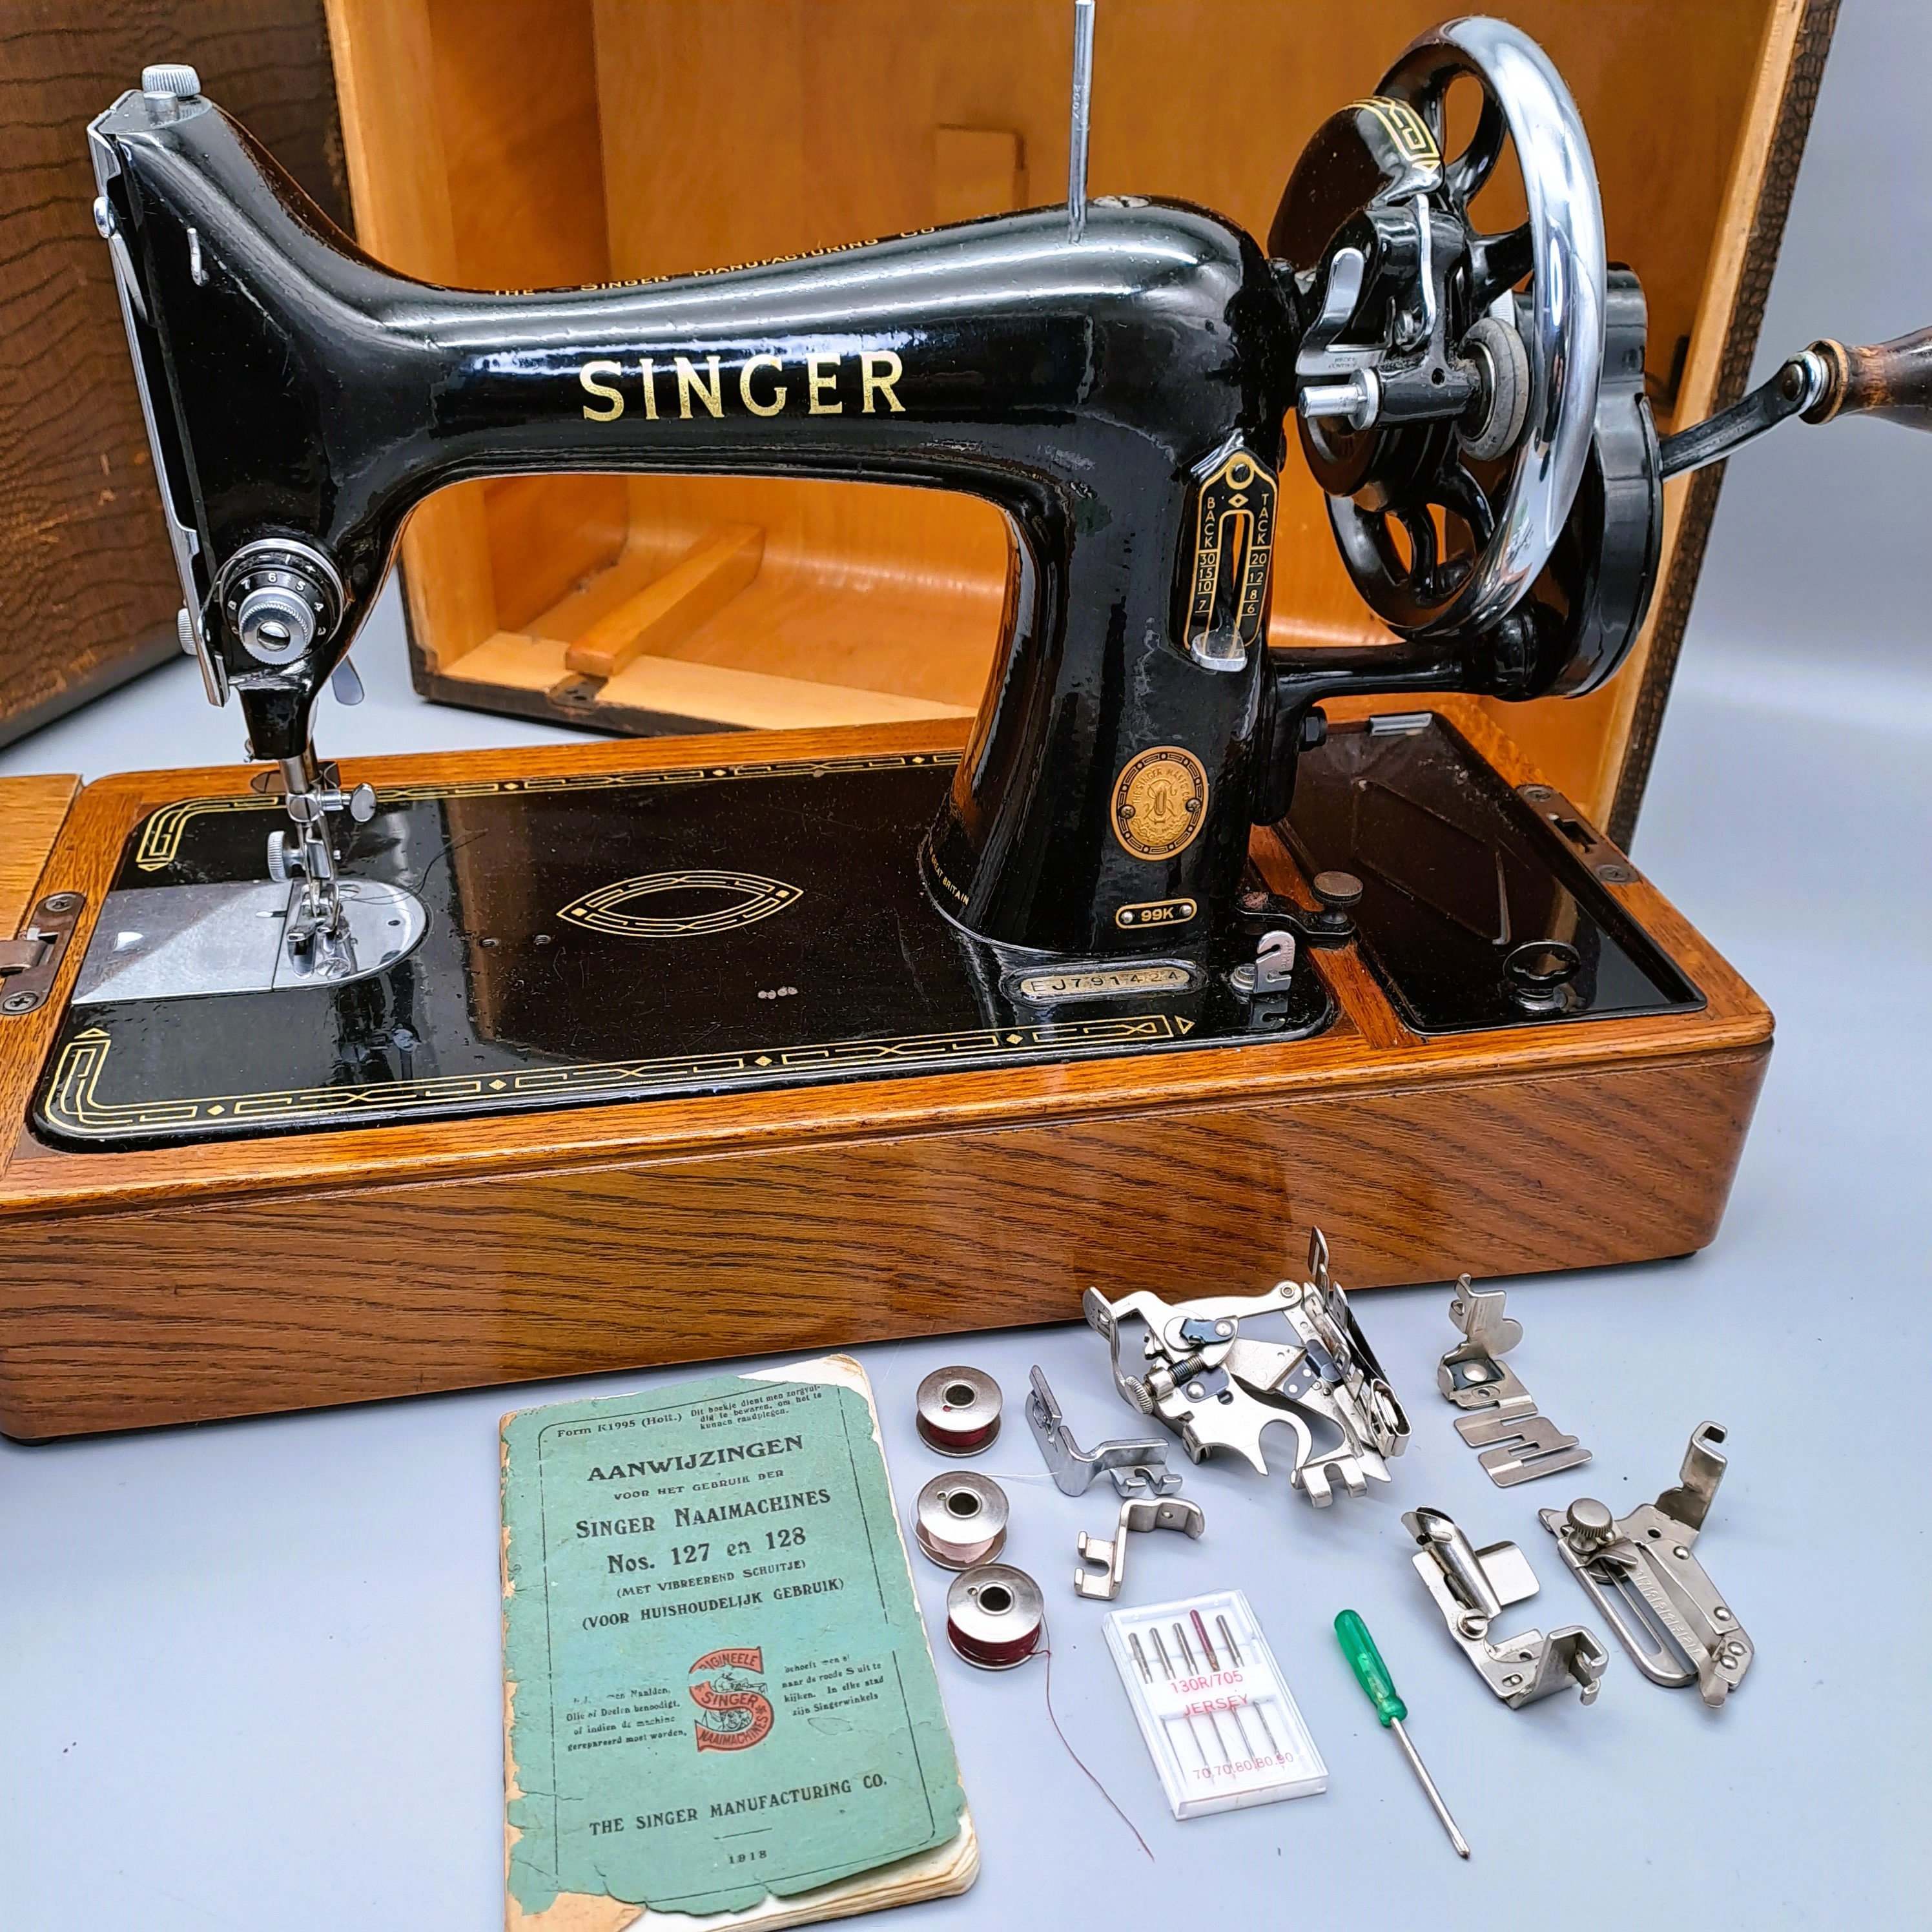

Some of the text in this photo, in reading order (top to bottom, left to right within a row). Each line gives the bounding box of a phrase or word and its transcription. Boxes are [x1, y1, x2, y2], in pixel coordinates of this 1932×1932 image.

[580, 350, 906, 422] SINGER
[1204, 497, 1215, 548] BACK
[1257, 493, 1269, 544] TACK
[1199, 553, 1215, 565] 30
[1251, 553, 1267, 565] 20
[268, 572, 277, 582] 6
[296, 581, 306, 591] 5
[1199, 568, 1213, 579] 15
[1249, 571, 1264, 582] 12
[1198, 581, 1212, 592] 10
[1249, 589, 1258, 600] 8
[1198, 600, 1207, 610] 7
[1247, 603, 1255, 613] 6
[942, 876, 969, 906] BRITAIN
[1141, 907, 1174, 922] 99K
[690, 1408, 704, 1417] Dit
[700, 1413, 714, 1423] dig
[796, 1394, 810, 1403] het
[557, 1428, 591, 1437] Form
[598, 1419, 636, 1433] K1995
[587, 1435, 804, 1481] AANWIJZINGEN
[613, 1469, 784, 1501] VOOR HET GEBRUIK DER
[576, 1488, 832, 1539] SINGER NAAIMACHINES
[607, 1526, 807, 1574] Nos. 127 en 128
[617, 1559, 806, 1599] (MET VIBREEREND SCHUITJE)
[582, 1577, 844, 1630] (VOOR HUISHOUDELIJK GEBRUIK)
[846, 1667, 855, 1675] S
[858, 1663, 871, 1673] uit
[827, 1686, 838, 1694] In
[842, 1681, 861, 1691] elke
[865, 1675, 884, 1687] stad
[1170, 1670, 1244, 1694] 130R/705
[701, 1690, 759, 1707] SINGER
[792, 1692, 879, 1716] zijn Singerwinkels
[1184, 1693, 1248, 1718] JERSEY
[566, 1711, 585, 1722] Olie
[587, 1723, 617, 1734] indien
[699, 1716, 769, 1745] NAAIMACHINES
[567, 1736, 622, 1752] gerepareerd
[589, 1773, 888, 1836] THE SINGER MANUFACTURING CO.
[728, 1849, 768, 1865] 1918
